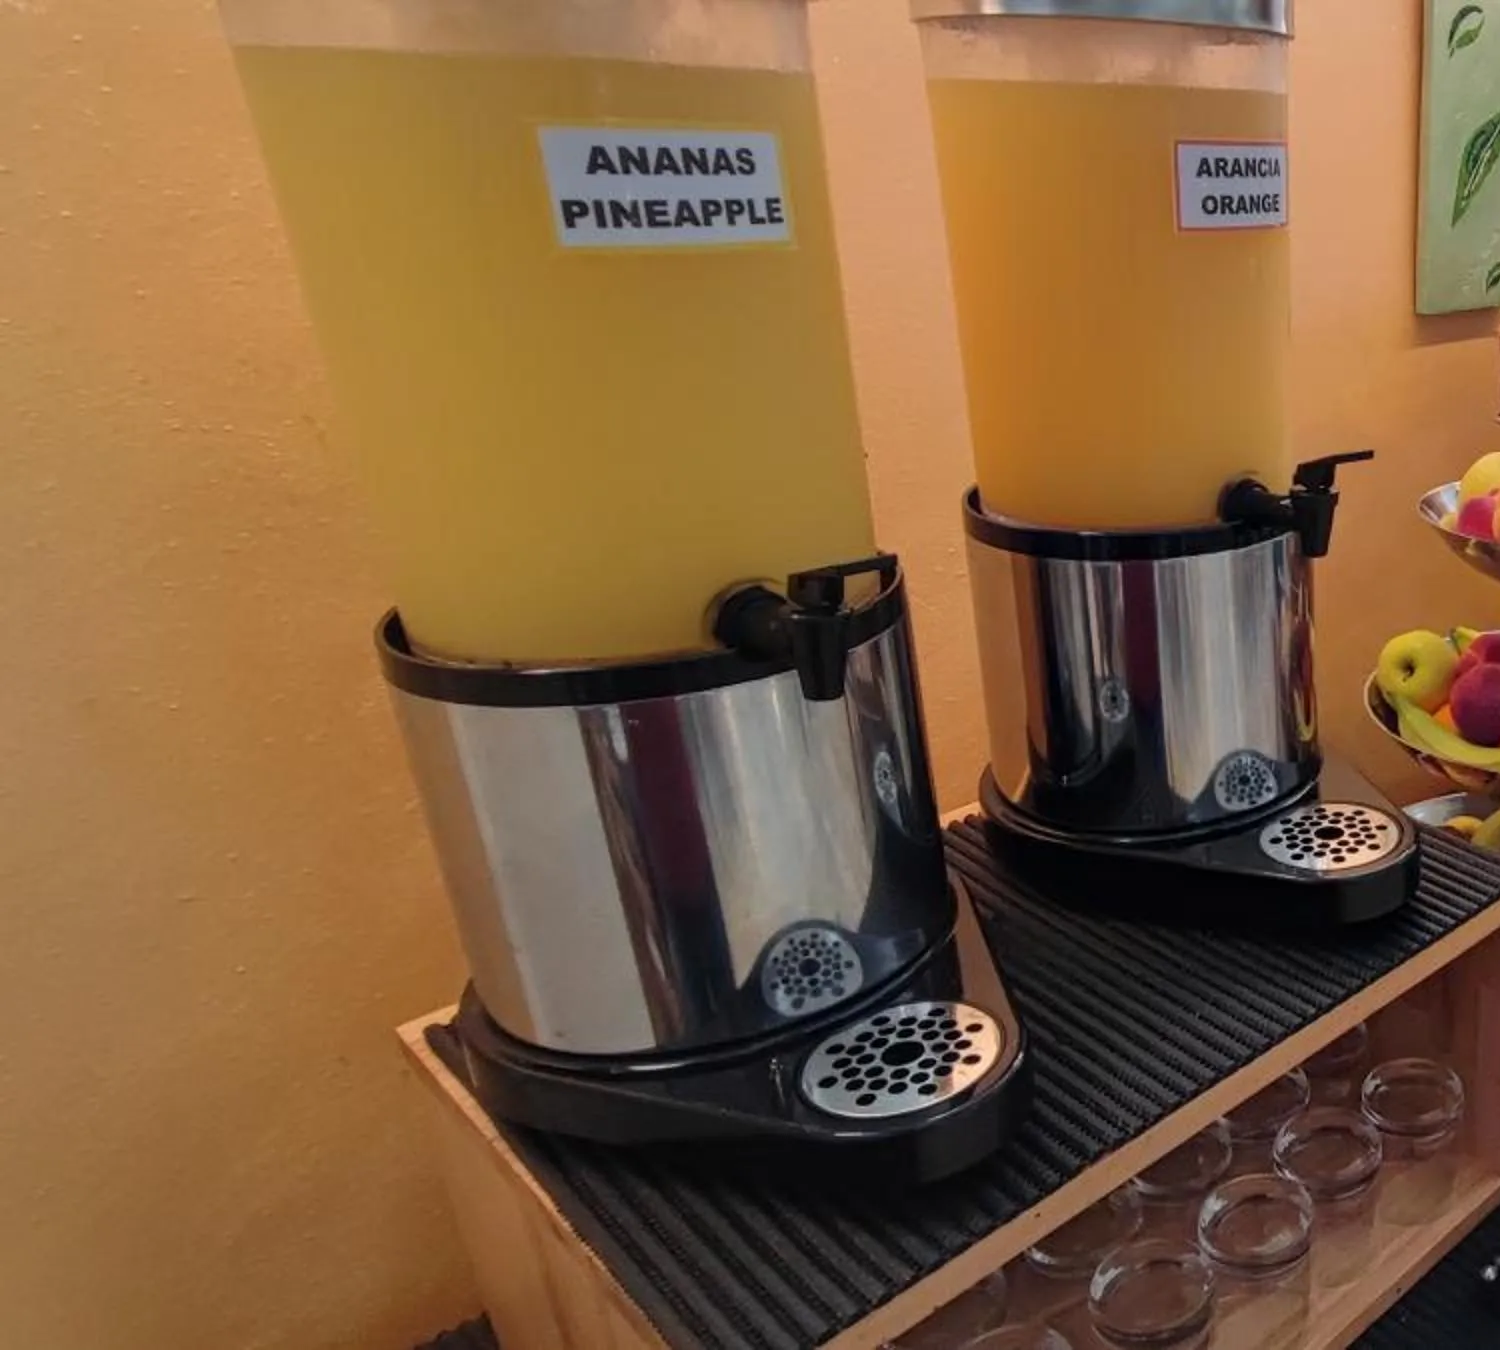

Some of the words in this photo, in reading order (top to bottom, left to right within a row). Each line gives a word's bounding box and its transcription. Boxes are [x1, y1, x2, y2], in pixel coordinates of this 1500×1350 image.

[585, 145, 756, 176] ANANAS
[1195, 156, 1281, 178] ARANCIA
[559, 197, 785, 229] PINEAPPLE
[1201, 193, 1280, 215] ORANGE
